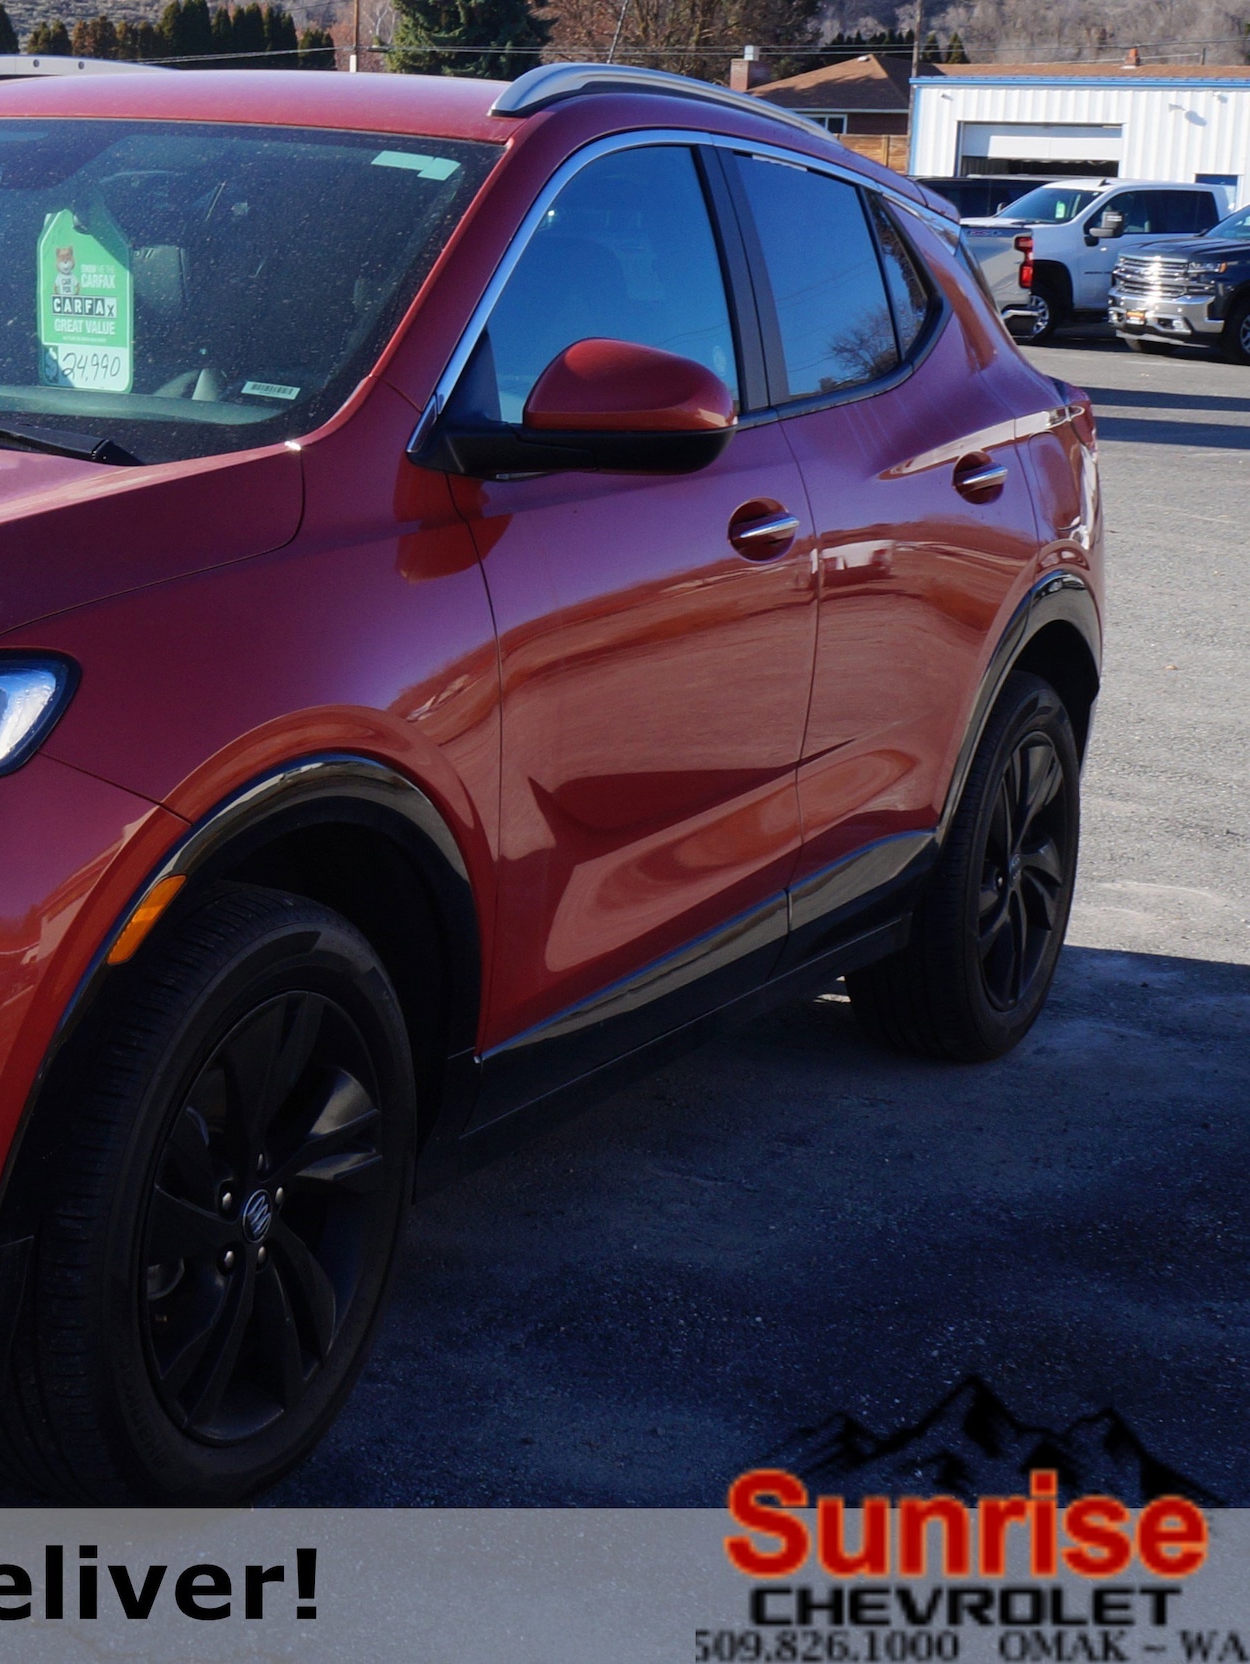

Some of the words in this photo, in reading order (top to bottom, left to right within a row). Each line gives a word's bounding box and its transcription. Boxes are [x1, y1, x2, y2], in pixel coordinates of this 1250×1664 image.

[81, 273, 116, 289] CARFAX
[52, 297, 116, 318] CARFAX
[54, 318, 84, 333] GREAT
[86, 319, 116, 335] VALUE
